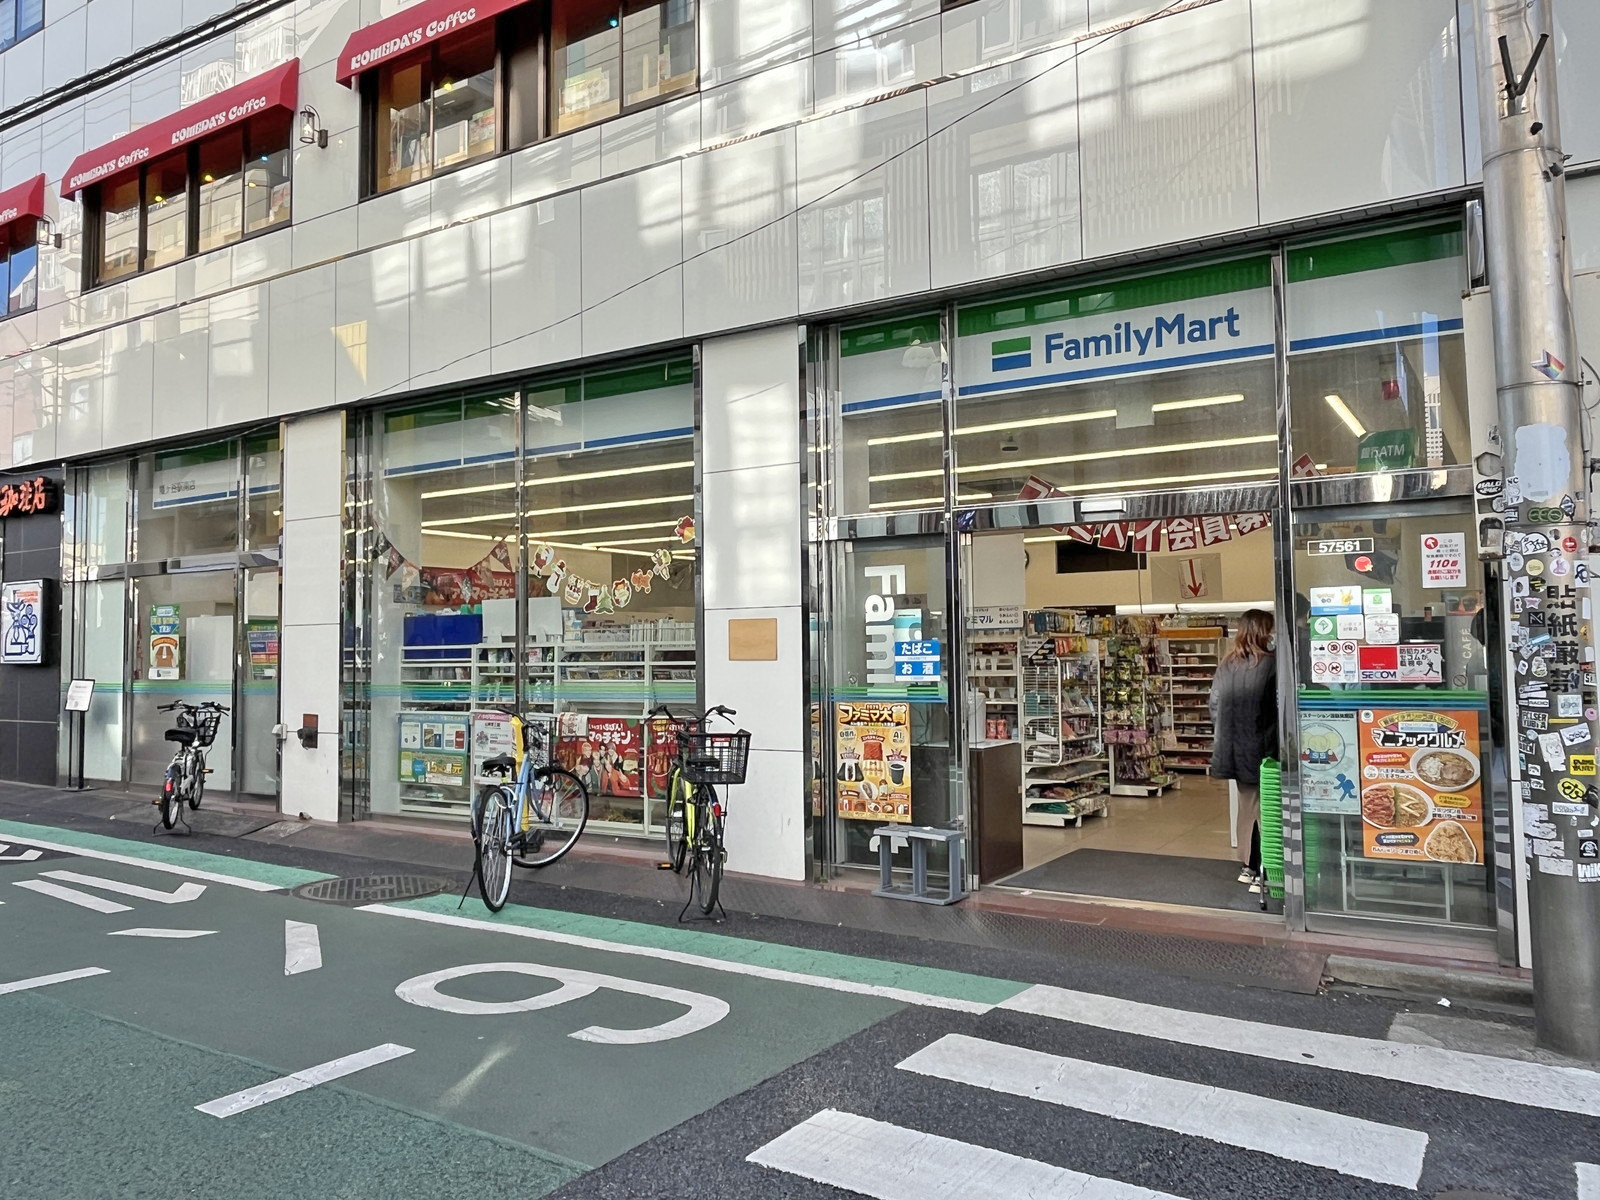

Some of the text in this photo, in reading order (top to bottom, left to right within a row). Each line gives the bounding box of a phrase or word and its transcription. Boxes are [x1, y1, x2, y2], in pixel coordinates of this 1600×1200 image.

[350, 7, 476, 71] KOMEDA'S Coffee
[171, 95, 266, 145] KOMEDA'S Coffee
[70, 146, 150, 188] KOMEDA'S Coffee
[1045, 307, 1240, 364] FamilyMart
[1381, 442, 1405, 457] ATM
[1318, 540, 1361, 553] 57561
[901, 643, 933, 655] たばこ
[1361, 671, 1397, 679] SECOM
[1373, 730, 1464, 748] マニアックグルメ
